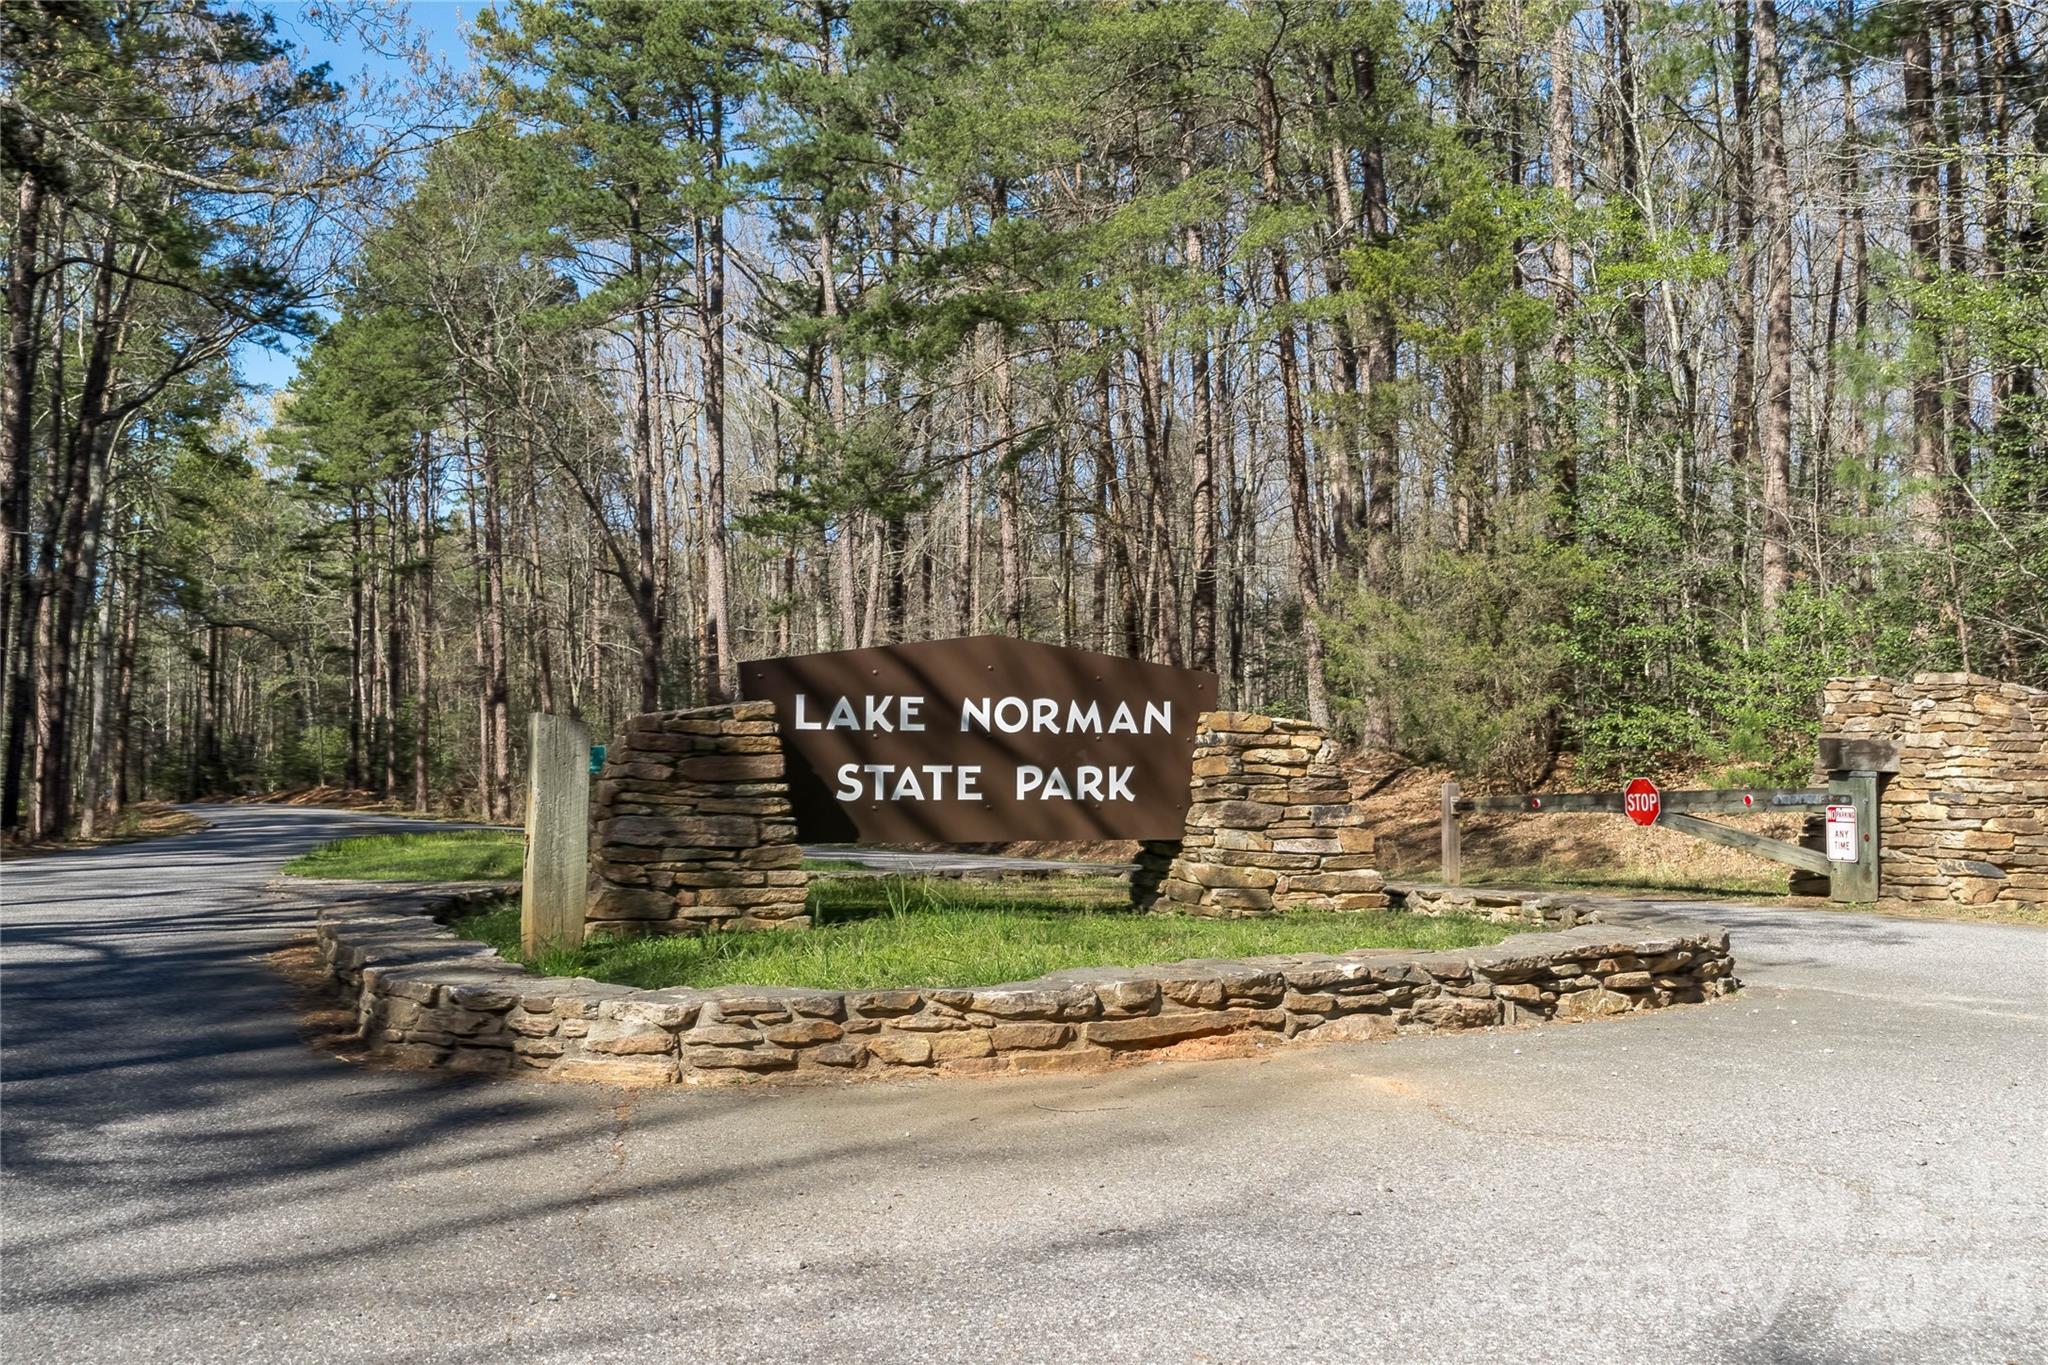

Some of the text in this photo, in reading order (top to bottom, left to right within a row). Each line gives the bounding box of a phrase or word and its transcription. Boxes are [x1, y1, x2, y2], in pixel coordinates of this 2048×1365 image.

[795, 694, 1172, 735] LAKE NORMAN
[836, 764, 1136, 802] STATE PARK
[1627, 793, 1657, 812] STOP
[1836, 810, 1856, 819] PARKING
[1834, 830, 1849, 839] ANY
[1834, 841, 1850, 851] TIME
